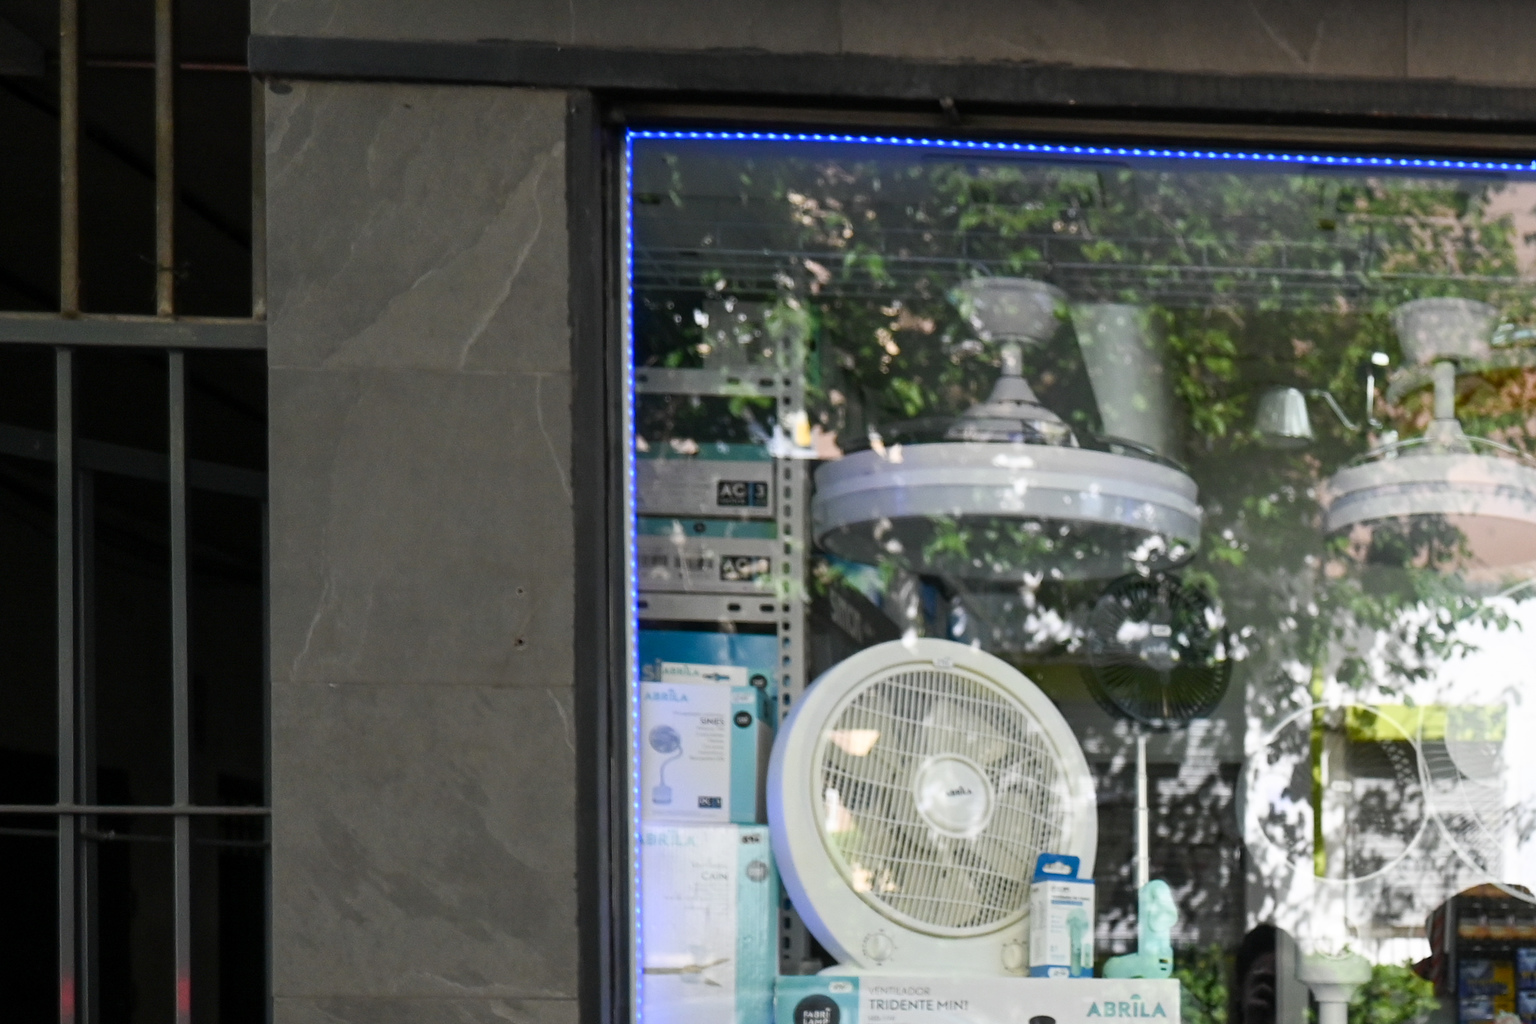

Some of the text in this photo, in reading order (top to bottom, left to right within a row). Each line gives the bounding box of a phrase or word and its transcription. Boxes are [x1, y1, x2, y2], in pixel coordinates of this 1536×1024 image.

[720, 483, 746, 498] AC
[868, 986, 931, 996] VENTILADOR
[869, 999, 934, 1011] TRIDENTE
